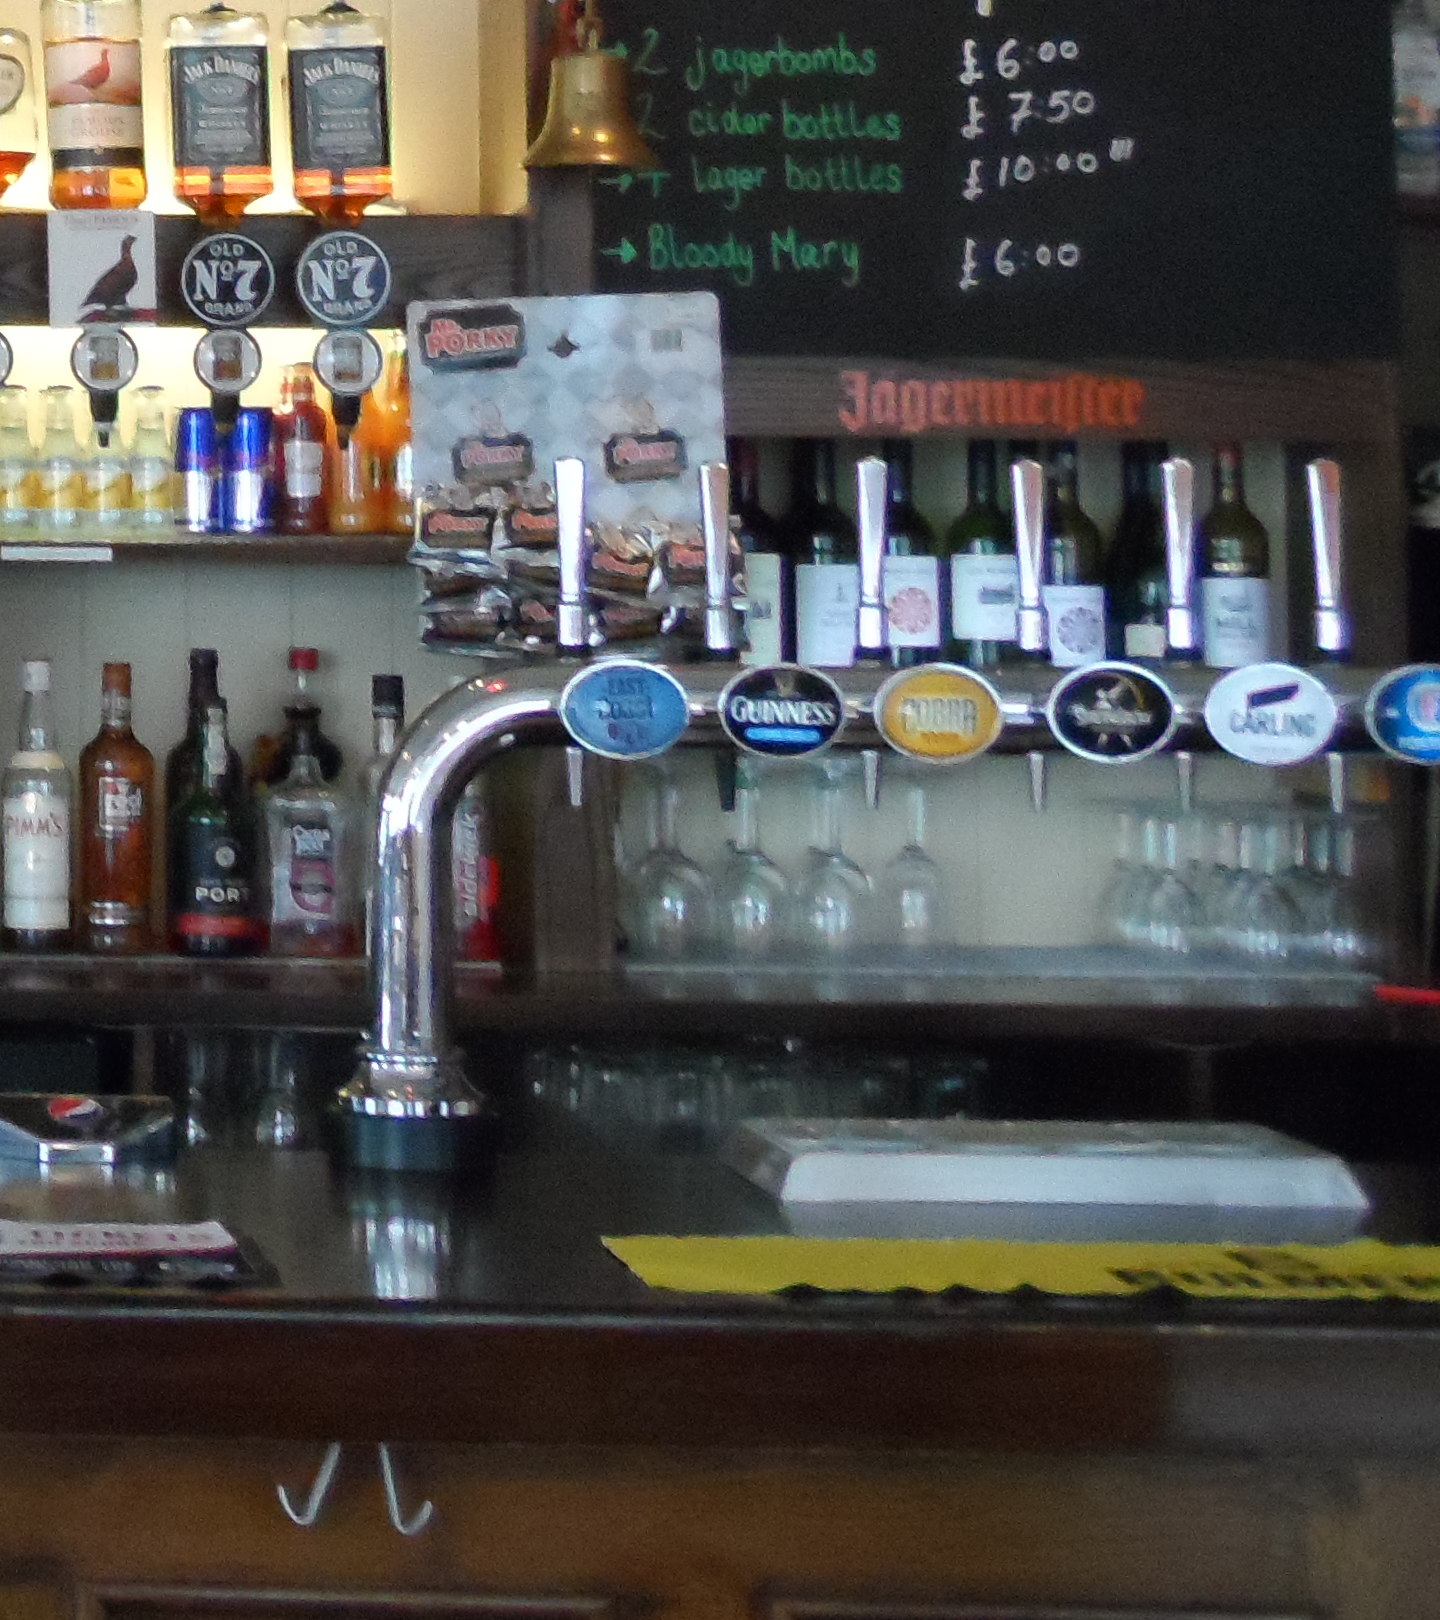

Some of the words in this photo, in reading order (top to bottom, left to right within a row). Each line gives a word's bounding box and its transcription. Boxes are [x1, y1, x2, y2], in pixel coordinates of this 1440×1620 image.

[632, 28, 668, 74] 2
[685, 32, 877, 96] jagerbombs
[688, 101, 772, 137] cider
[782, 98, 902, 141] bottles
[693, 155, 767, 210] lager
[784, 153, 904, 193] bottles
[209, 243, 244, 257] OLD
[323, 242, 358, 256] OLD
[649, 223, 753, 286] Bloody
[771, 225, 861, 286] Mary
[730, 694, 838, 726] GUINNESS
[1228, 708, 1316, 738] CARLING
